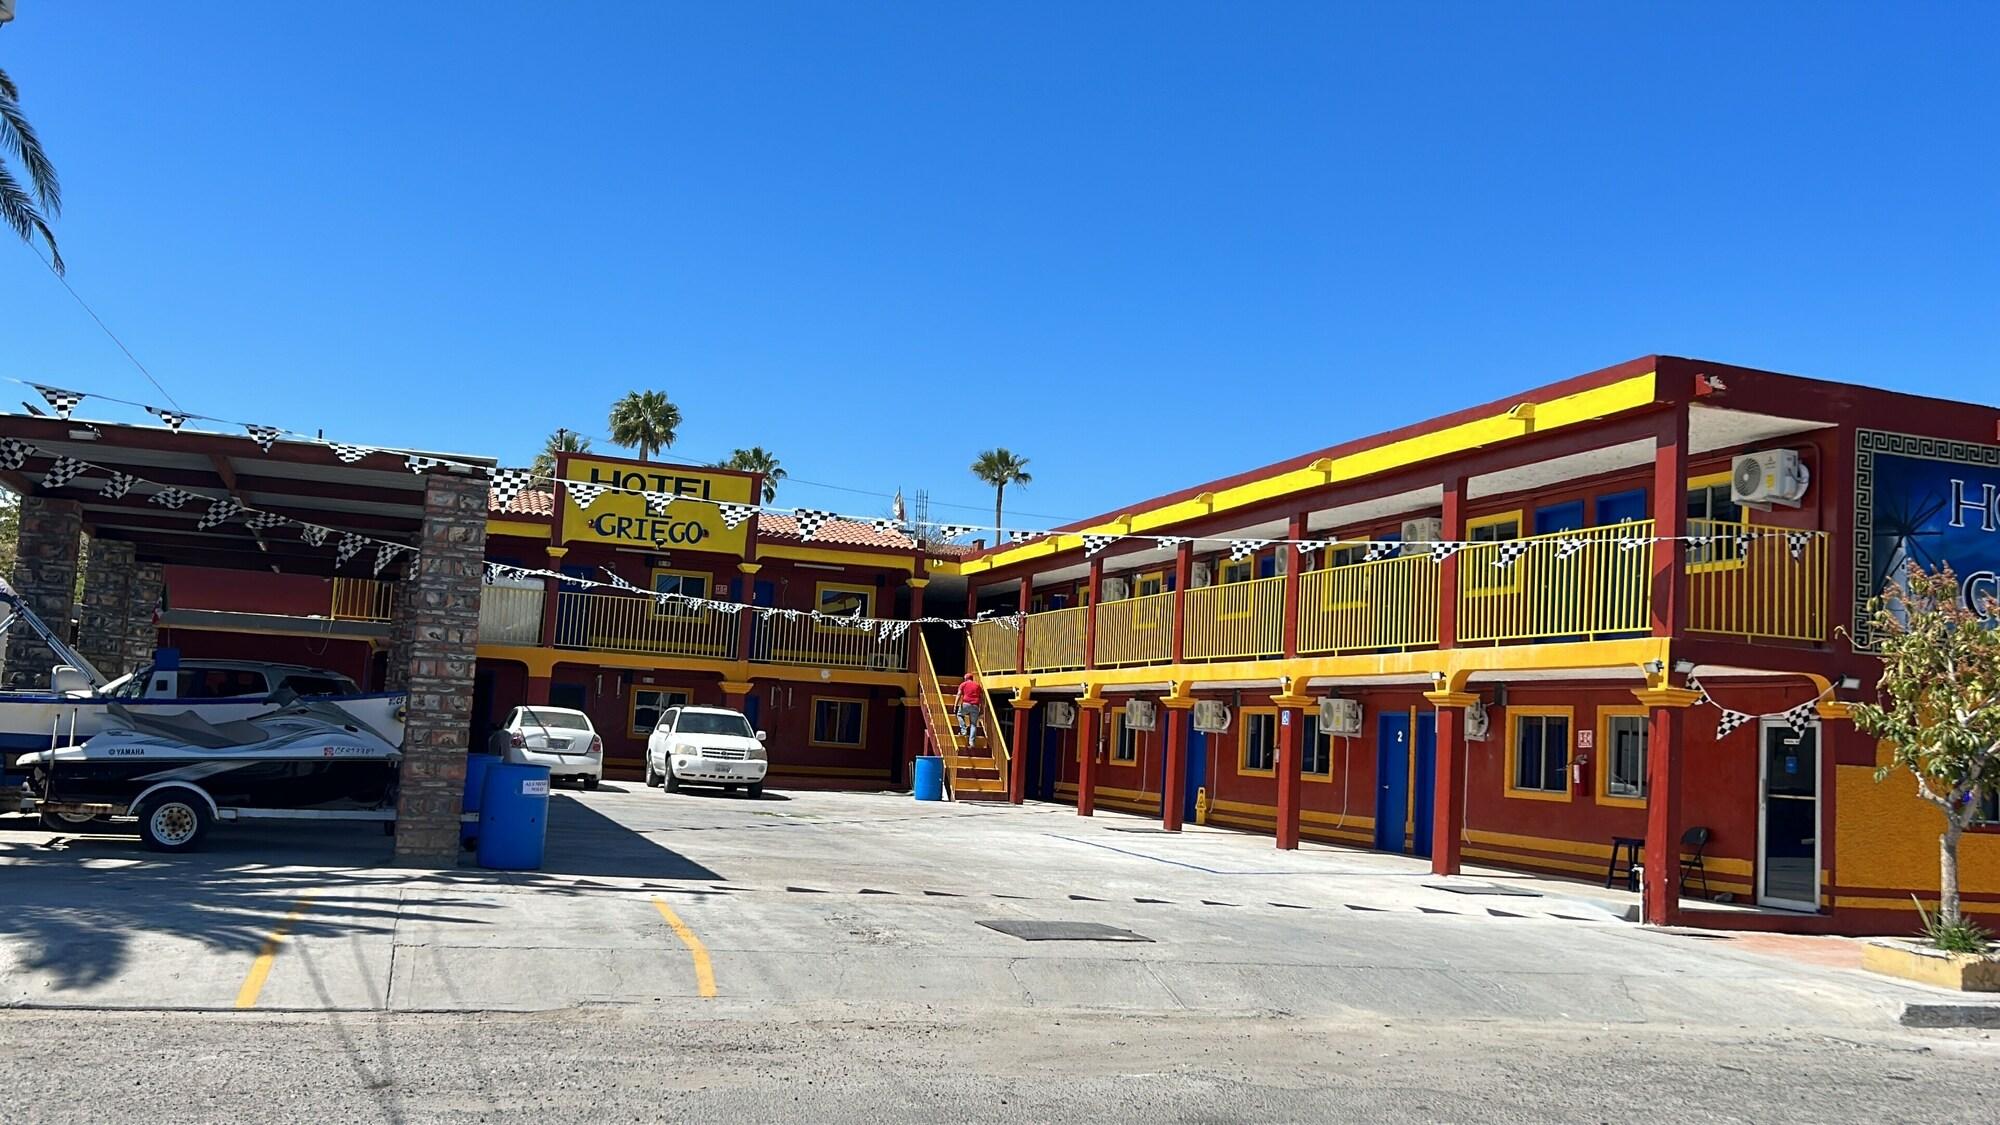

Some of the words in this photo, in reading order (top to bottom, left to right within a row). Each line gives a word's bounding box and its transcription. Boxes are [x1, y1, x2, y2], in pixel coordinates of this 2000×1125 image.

[590, 468, 720, 504] HOTEL
[1949, 479, 2000, 531] H
[594, 513, 704, 544] GRIEGO
[1397, 730, 1403, 742] 2
[116, 748, 144, 756] YAMAHA
